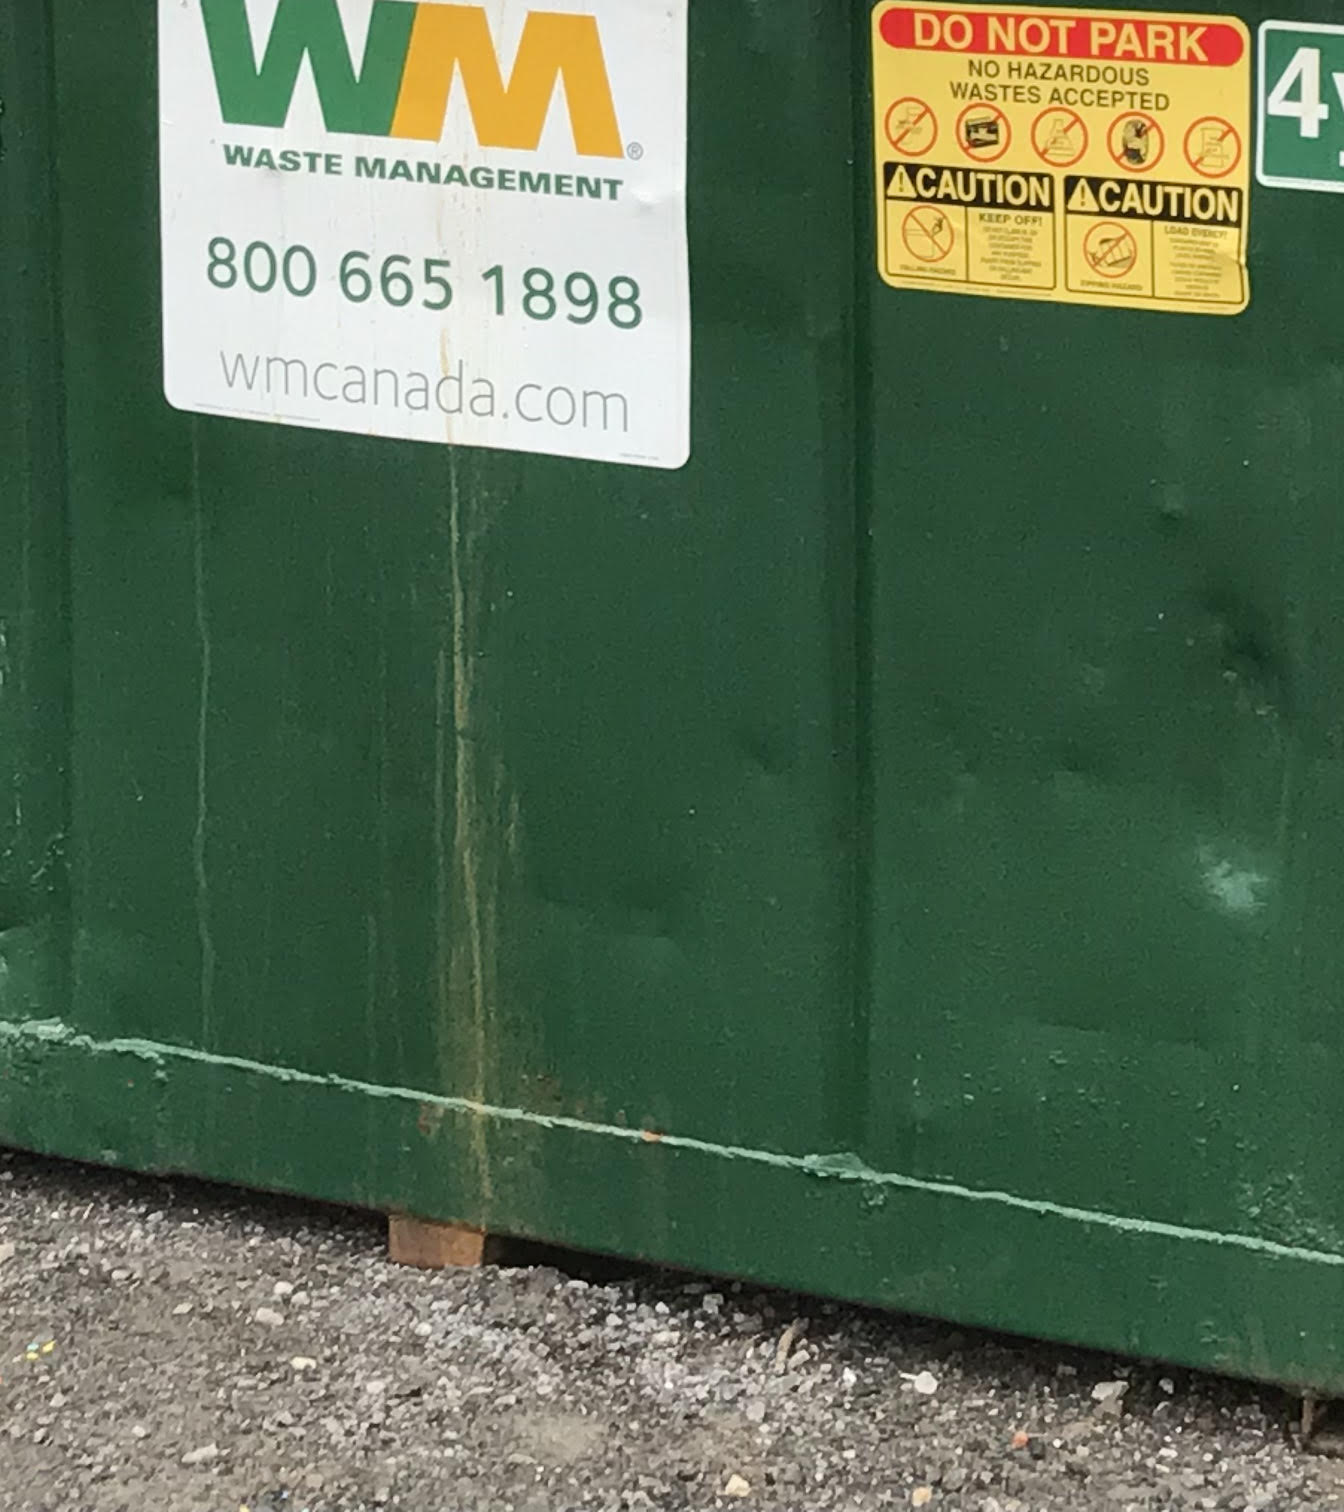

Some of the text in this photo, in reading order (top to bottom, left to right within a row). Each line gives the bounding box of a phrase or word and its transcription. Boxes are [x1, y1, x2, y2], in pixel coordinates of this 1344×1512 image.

[913, 12, 1208, 62] DO NOT PARK
[968, 59, 1149, 87] NO HAZARDOUS
[950, 81, 1170, 112] WASTES ACCEPTED
[223, 144, 624, 200] WASTE MANAGEMENT
[915, 167, 1050, 207] CAUTION
[979, 212, 1012, 225] KEEP
[1099, 181, 1239, 223] CAUTION
[206, 236, 643, 330] 800 665 1898
[219, 349, 628, 433] wmcanada.com
